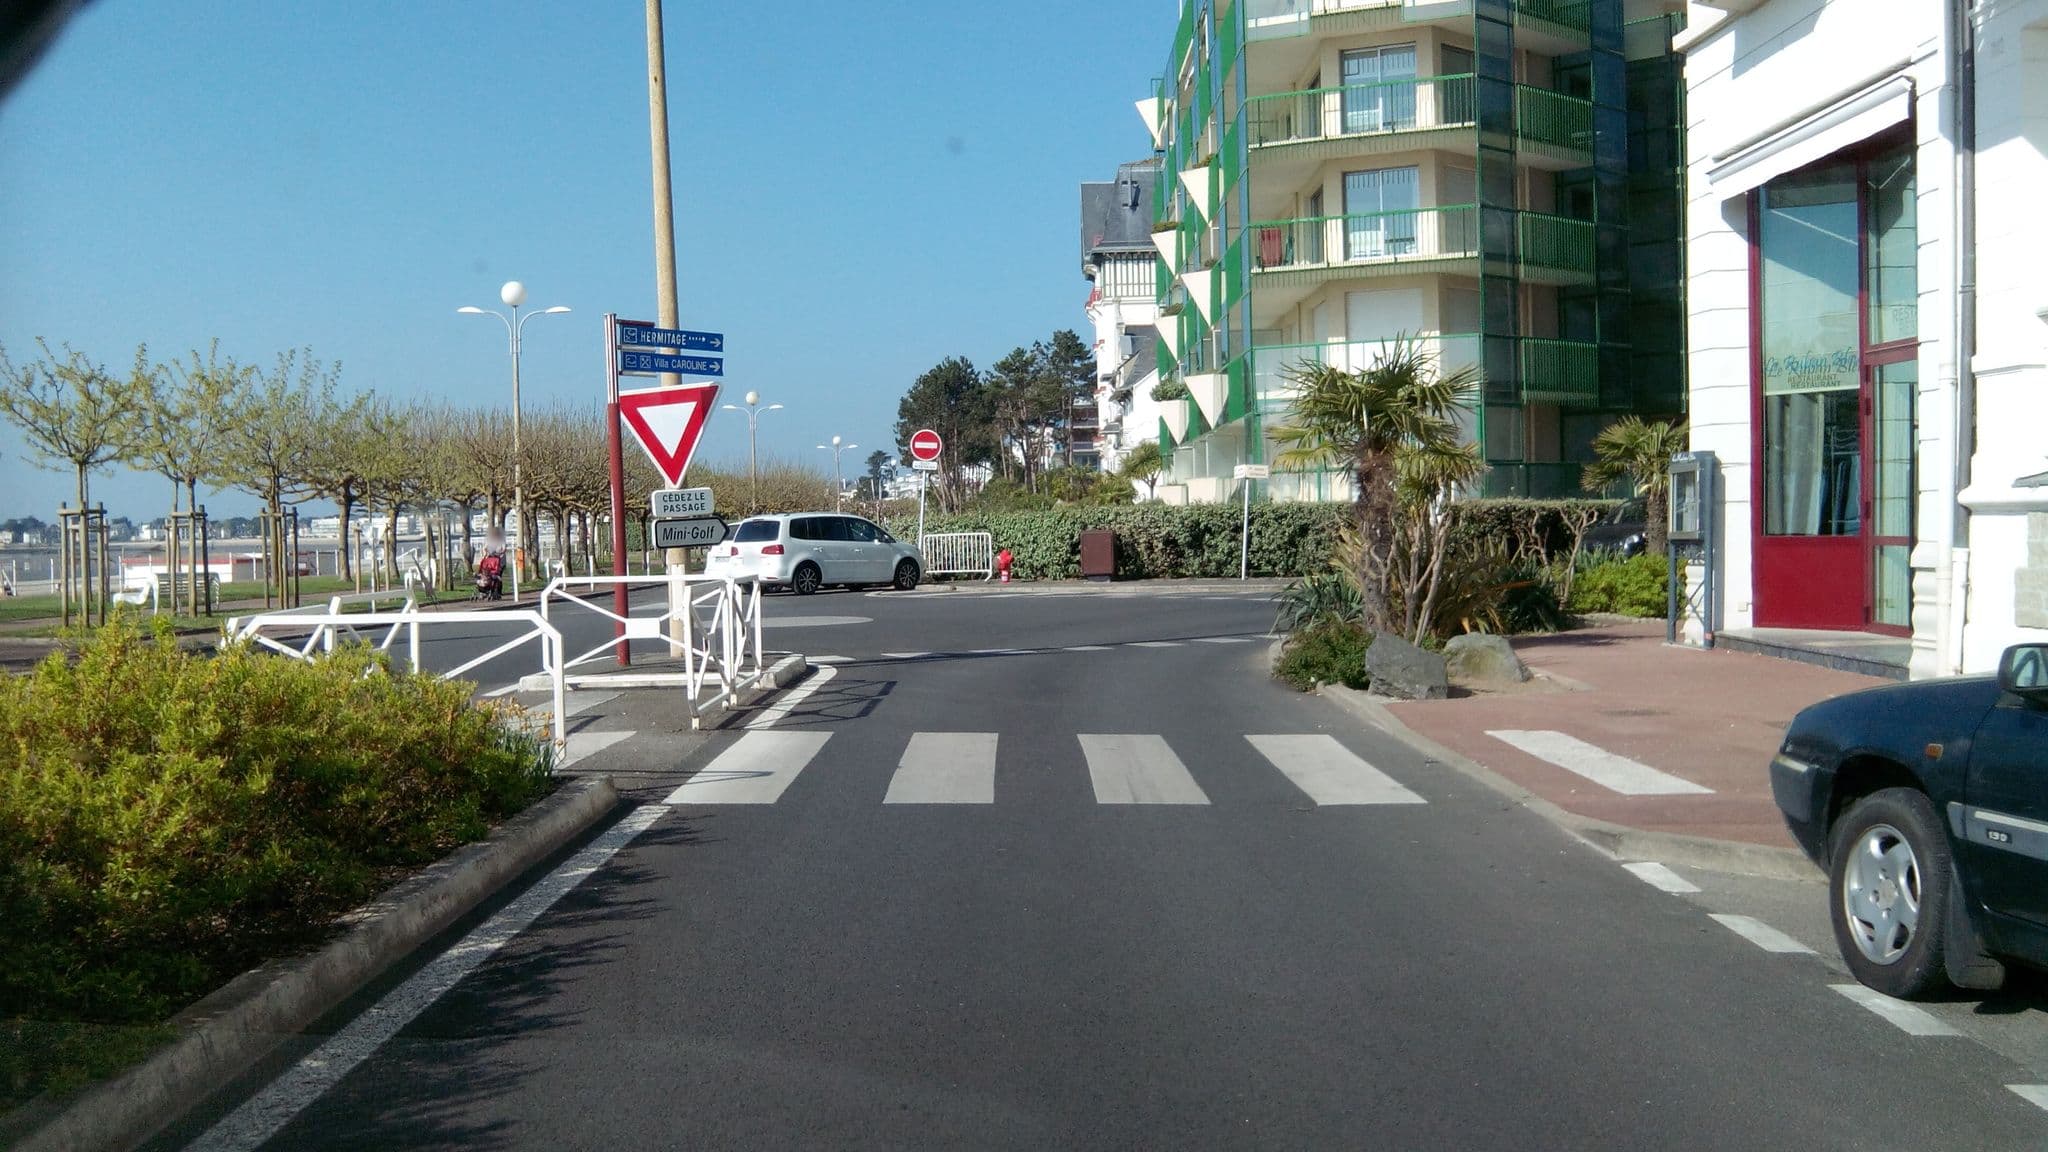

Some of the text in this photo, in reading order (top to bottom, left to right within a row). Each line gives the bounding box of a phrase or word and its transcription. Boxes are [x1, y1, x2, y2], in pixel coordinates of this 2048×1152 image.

[640, 330, 687, 345] HERMITAGE
[654, 358, 707, 371] Villa CAROLINE
[662, 492, 706, 503] CÉDEZ LE
[663, 502, 706, 513] PASSAGE
[662, 525, 715, 541] Mini-Golf
